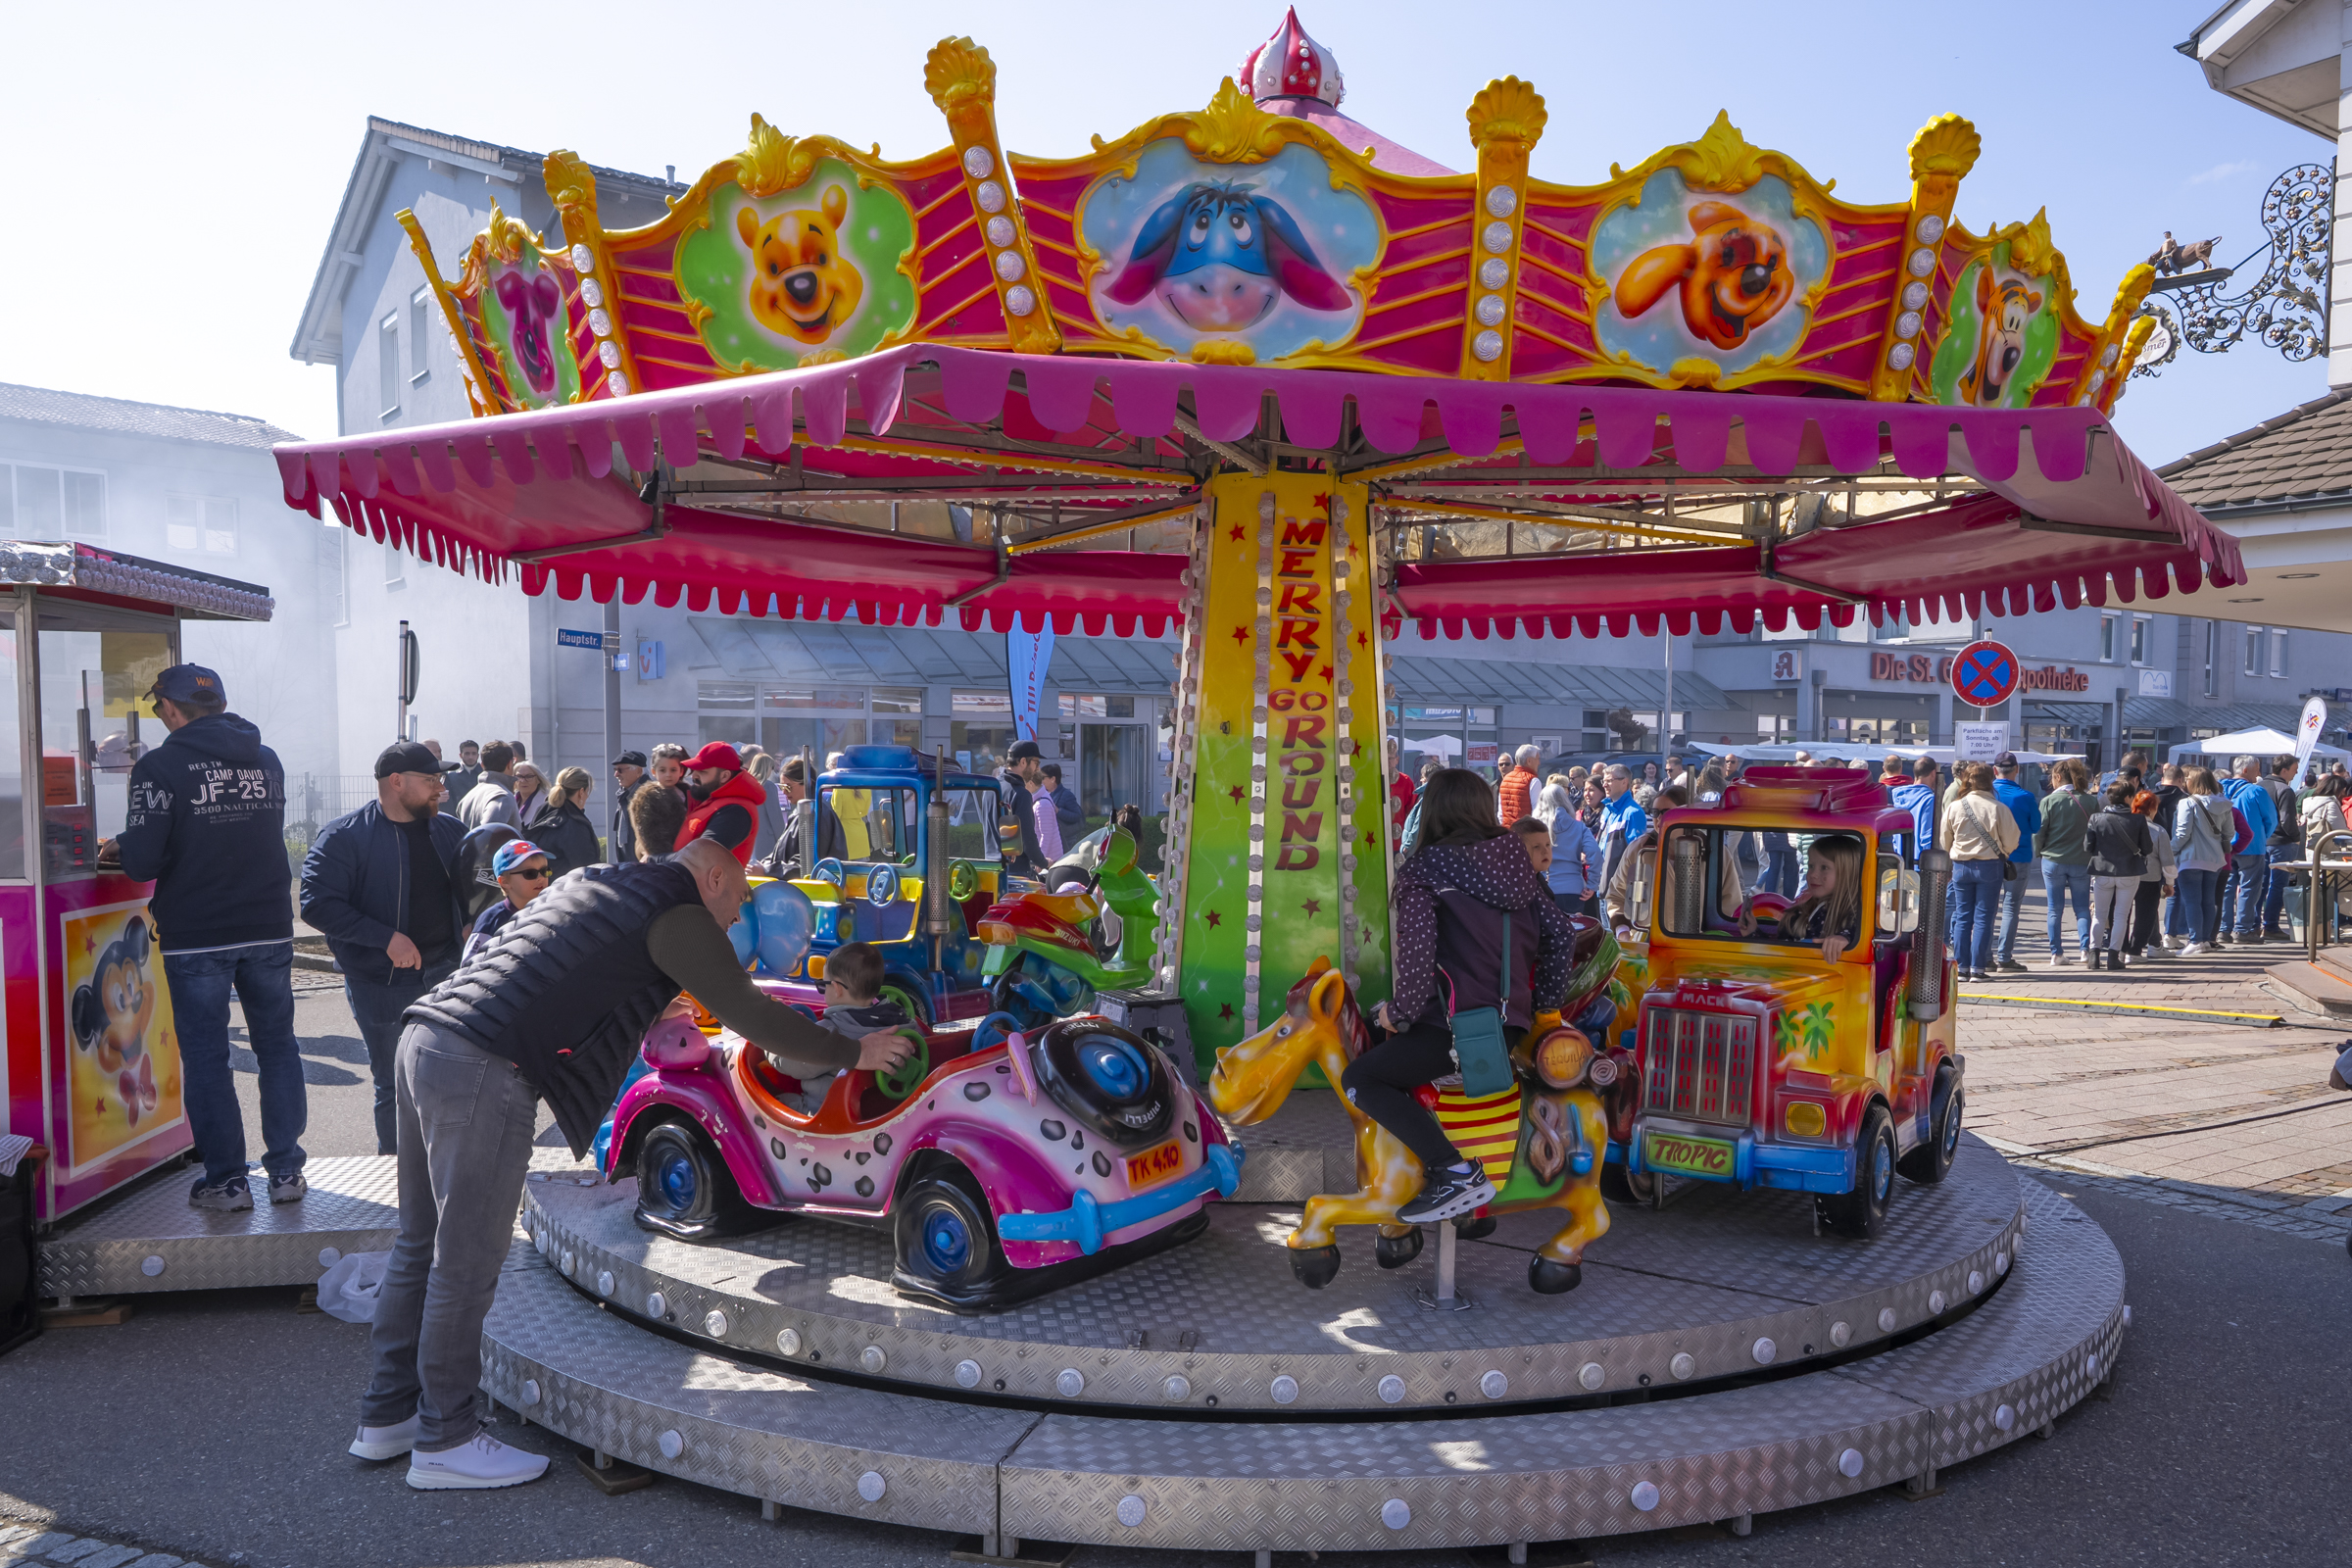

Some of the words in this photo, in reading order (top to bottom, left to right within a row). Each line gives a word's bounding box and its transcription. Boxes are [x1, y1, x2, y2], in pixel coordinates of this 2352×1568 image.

[1276, 516, 1328, 683] MERRY
[560, 631, 599, 646] Hauptstr.
[1872, 652, 1907, 681] Die
[1908, 654, 1936, 683] St.
[1268, 688, 1329, 711] GO
[205, 769, 234, 782] CAMP
[236, 768, 265, 781] DAVID
[1273, 715, 1328, 871] ROUND
[194, 805, 221, 815] 3500
[223, 802, 274, 812] NAUTICAL
[1054, 928, 1081, 947] SUZUKI
[1682, 993, 1727, 1008] MACK
[1125, 1100, 1161, 1124] PIRELLI
[1653, 1139, 1729, 1170] TROPIC
[1128, 1157, 1151, 1183] TK
